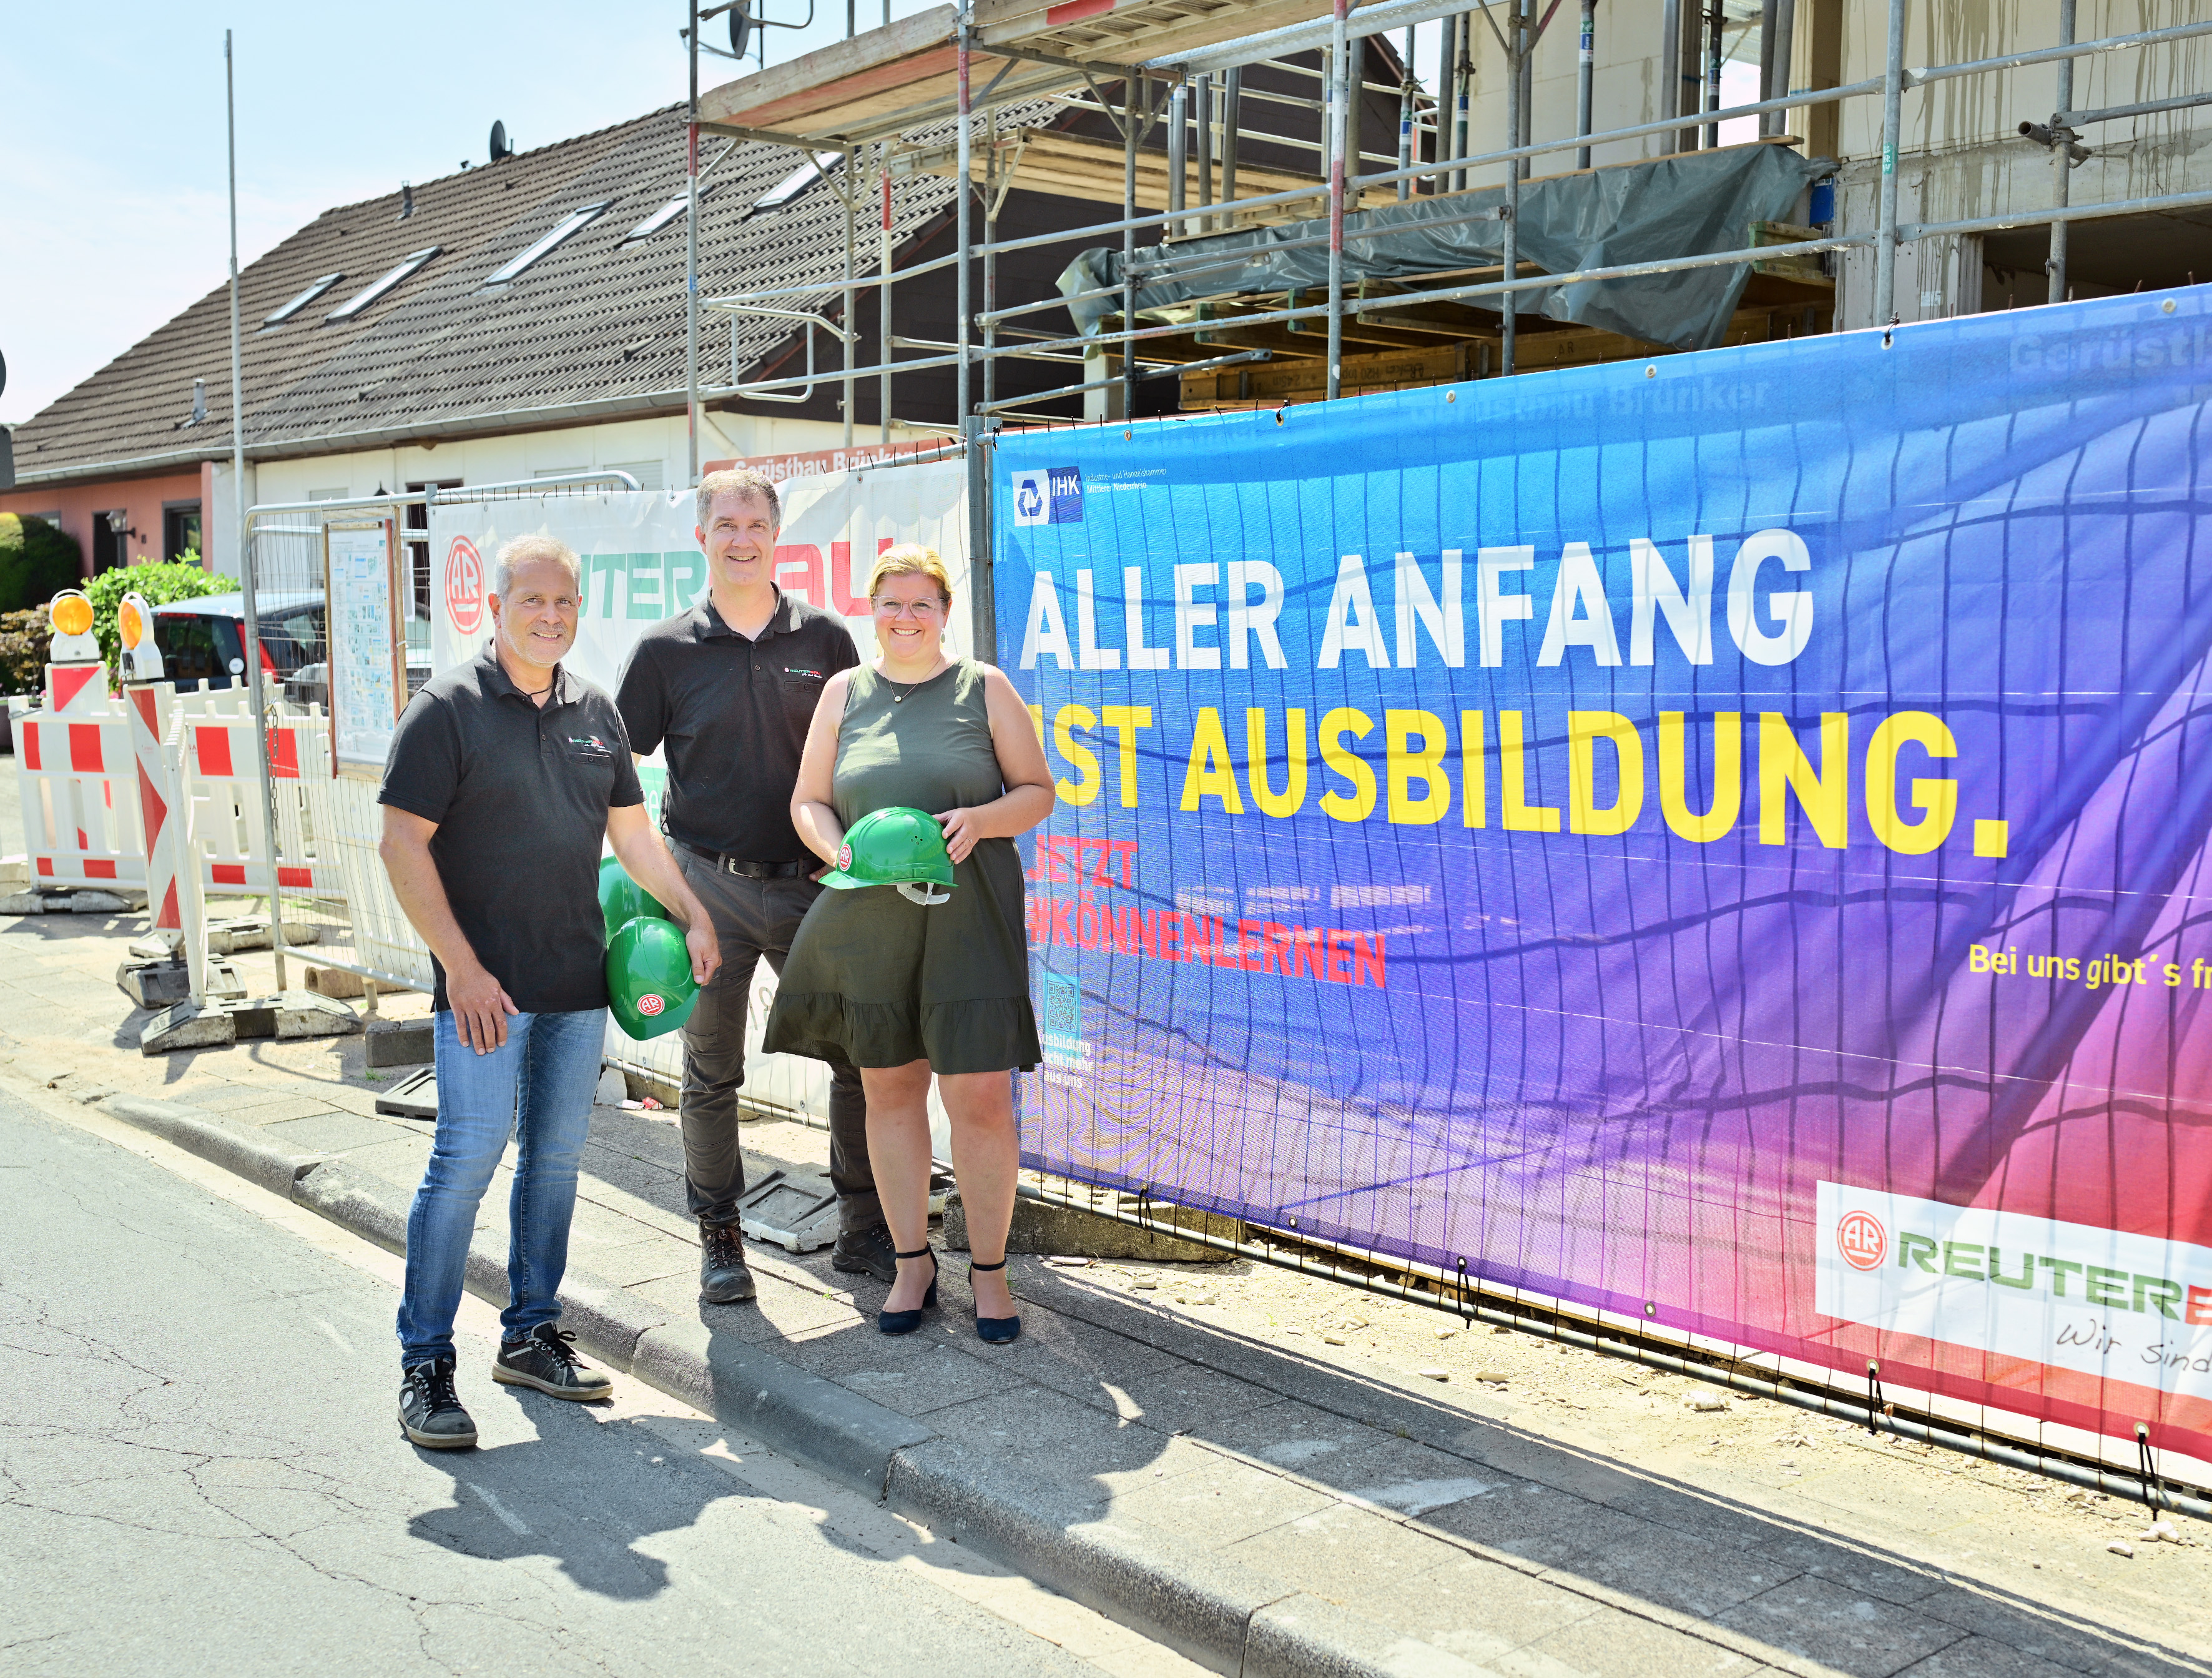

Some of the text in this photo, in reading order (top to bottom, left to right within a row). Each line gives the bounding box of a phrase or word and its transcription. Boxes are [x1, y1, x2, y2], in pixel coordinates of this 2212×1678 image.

[1052, 475, 1079, 496] IHK
[1085, 468, 1167, 482] Industrie- und Handelskammer
[1086, 480, 1147, 493] Mittlerer Niederrhein
[1019, 528, 1814, 671] ALLER ANFANG
[1179, 707, 2008, 858] AUSBILDUNG.
[1026, 834, 1138, 890] JETZT
[1028, 891, 1385, 989] #KÖNNENLERNEN
[1969, 944, 2017, 975] Bei
[2027, 954, 2081, 980] uns
[1044, 1070, 1083, 1088] aus uns
[2057, 1318, 2122, 1355] Wir
